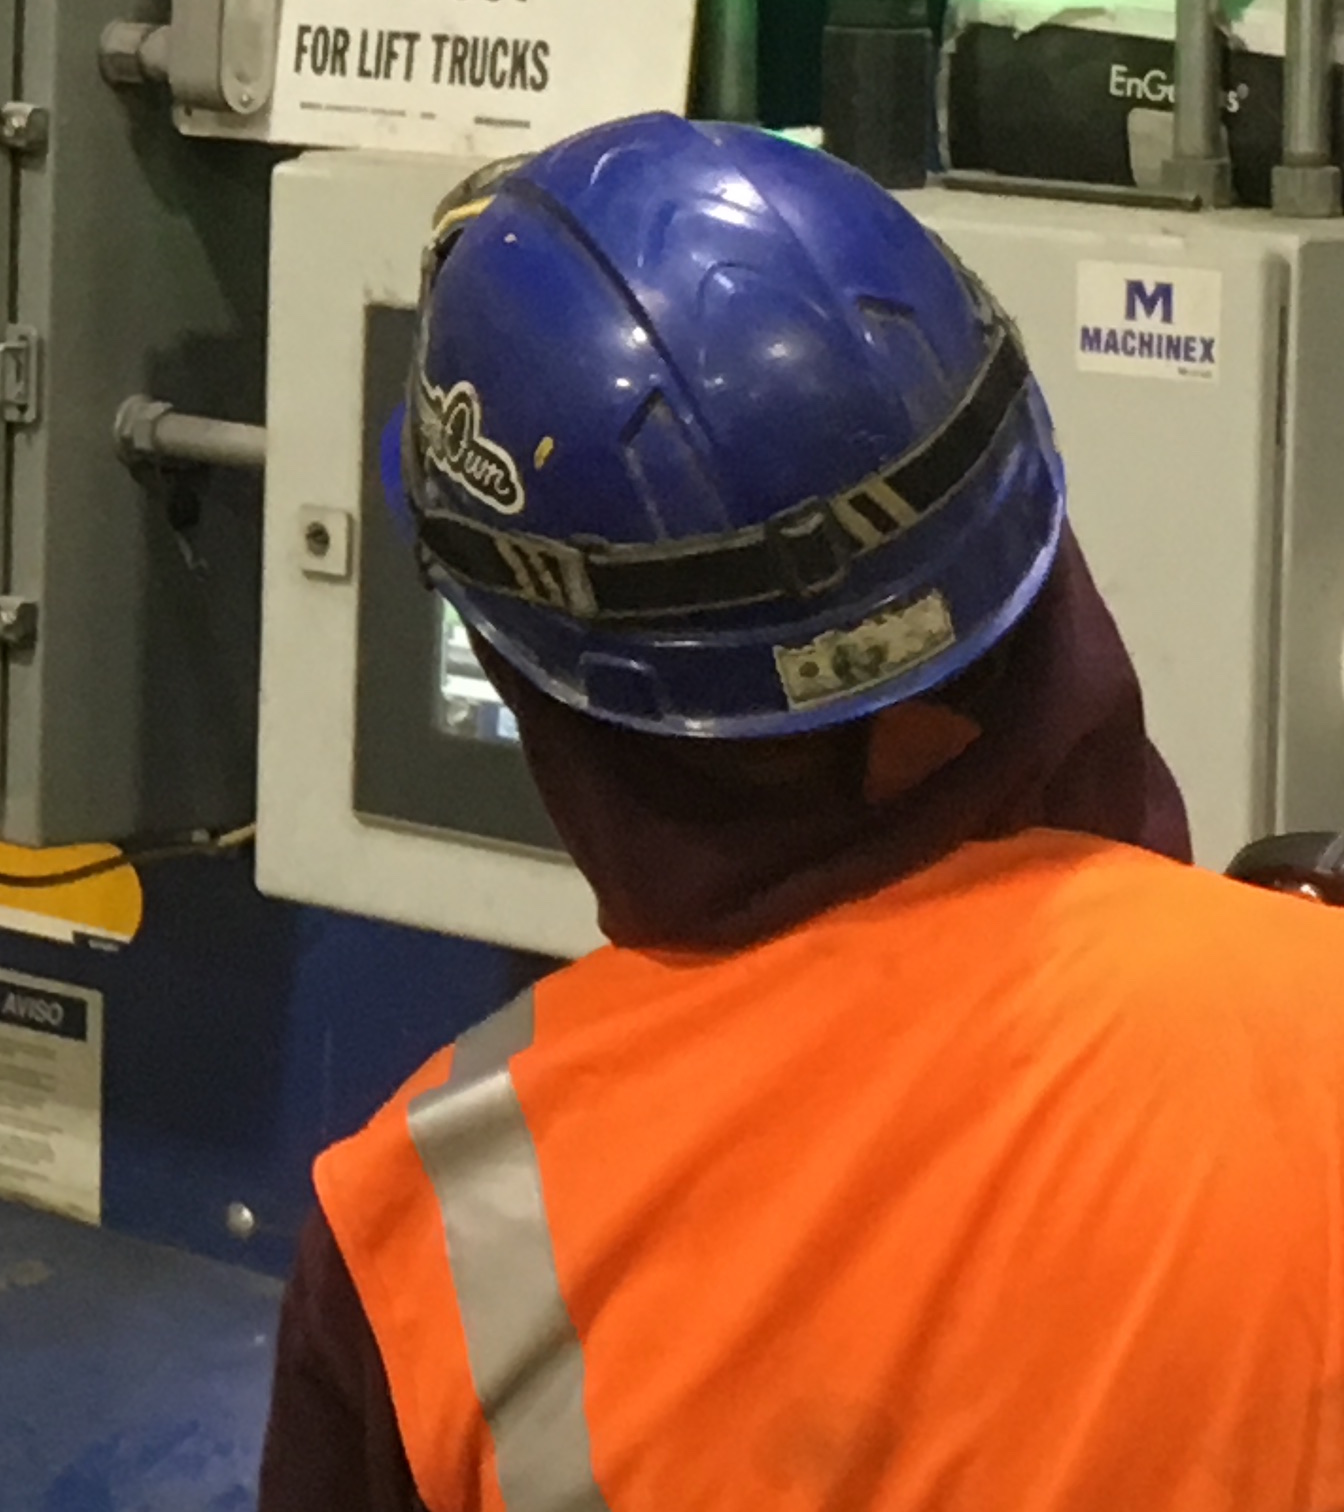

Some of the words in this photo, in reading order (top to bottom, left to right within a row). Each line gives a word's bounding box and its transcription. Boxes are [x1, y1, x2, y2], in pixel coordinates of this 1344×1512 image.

[294, 24, 349, 77] FOR
[358, 28, 422, 84] LIFT
[432, 33, 551, 93] TRUCKS
[1124, 278, 1175, 325] M
[1079, 325, 1216, 366] MACHINEX
[1, 991, 63, 1026] AVISO
